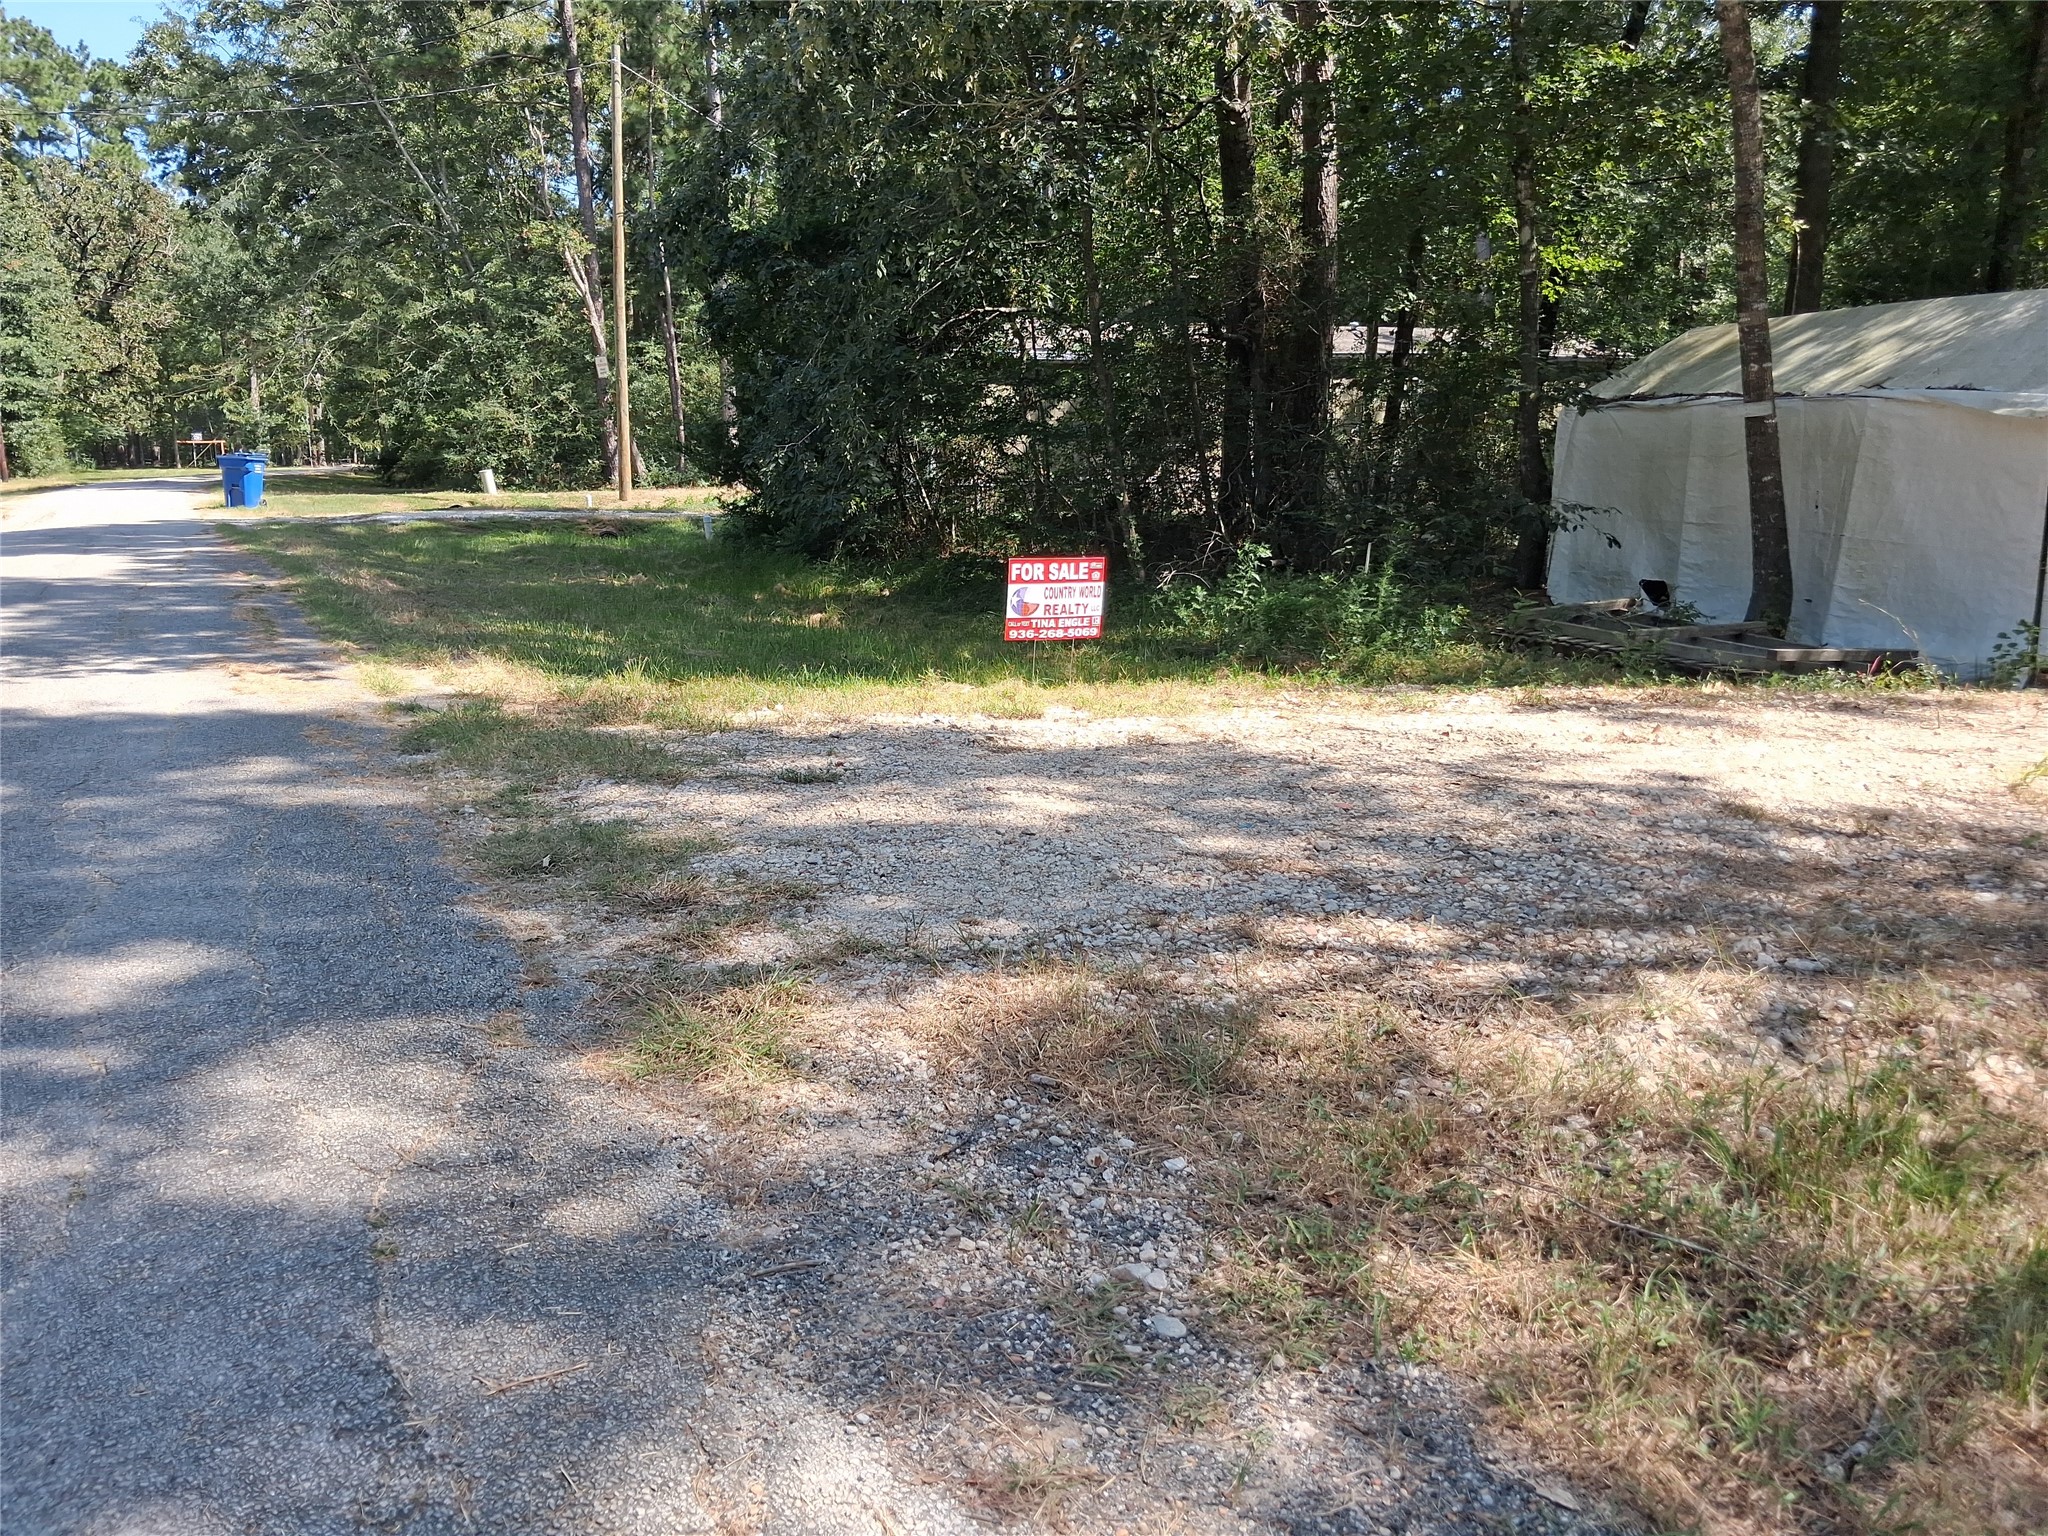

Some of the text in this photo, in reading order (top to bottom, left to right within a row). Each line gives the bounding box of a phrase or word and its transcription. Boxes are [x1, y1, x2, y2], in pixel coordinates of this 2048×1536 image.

[1011, 562, 1089, 581] FOR SALE
[1043, 585, 1102, 600] COUNTRY WORLD
[1043, 603, 1089, 616] REALTY
[1031, 618, 1056, 628] TINA
[1058, 617, 1091, 627] ENGLE
[1009, 627, 1098, 639] 936-268-5069
